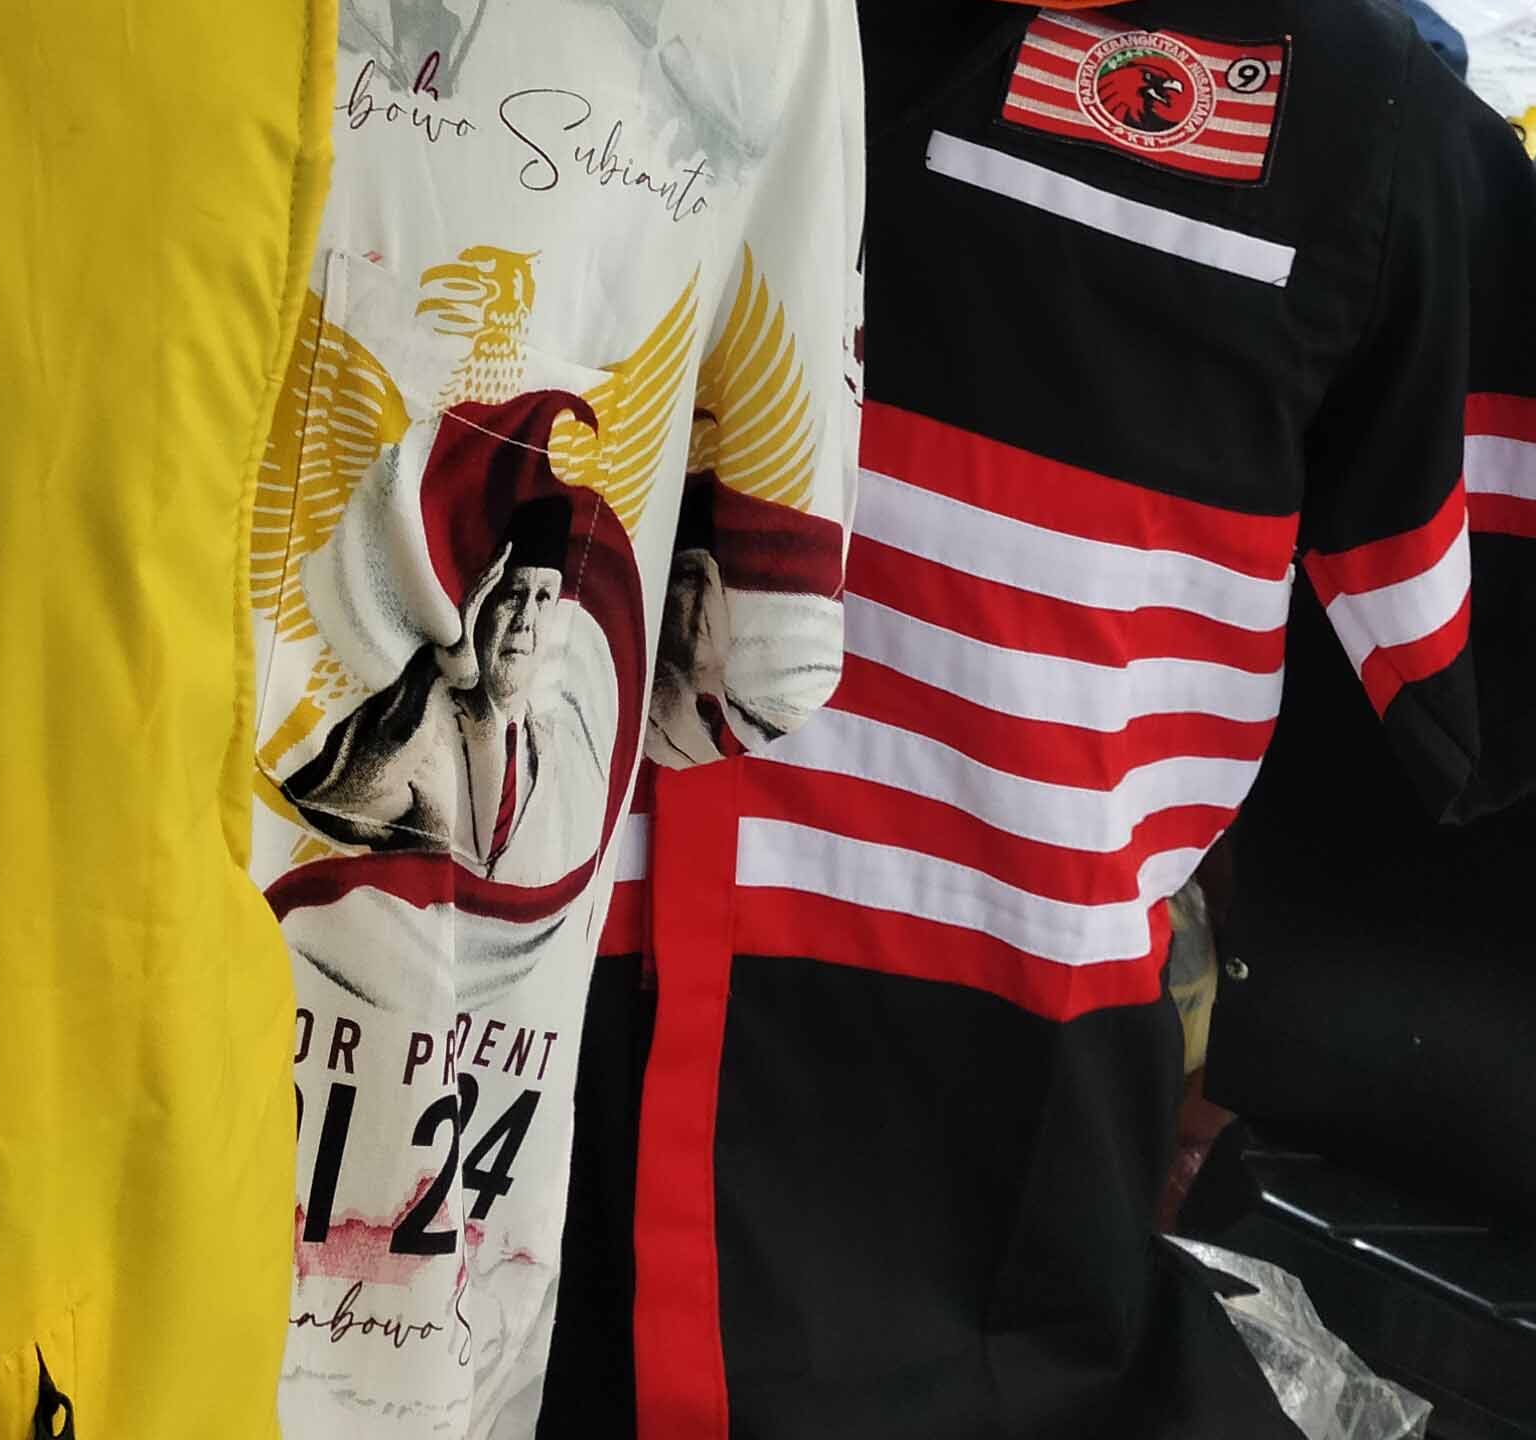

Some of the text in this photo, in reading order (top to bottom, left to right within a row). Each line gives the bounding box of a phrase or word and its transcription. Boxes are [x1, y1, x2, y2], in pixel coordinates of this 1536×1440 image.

[337, 59, 708, 222] bowo Subianto
[1094, 34, 1190, 62] KEBANGKITAN
[1185, 62, 1212, 133] NUSANTARA
[1237, 64, 1261, 88] 9
[388, 1071, 542, 1256] 24
